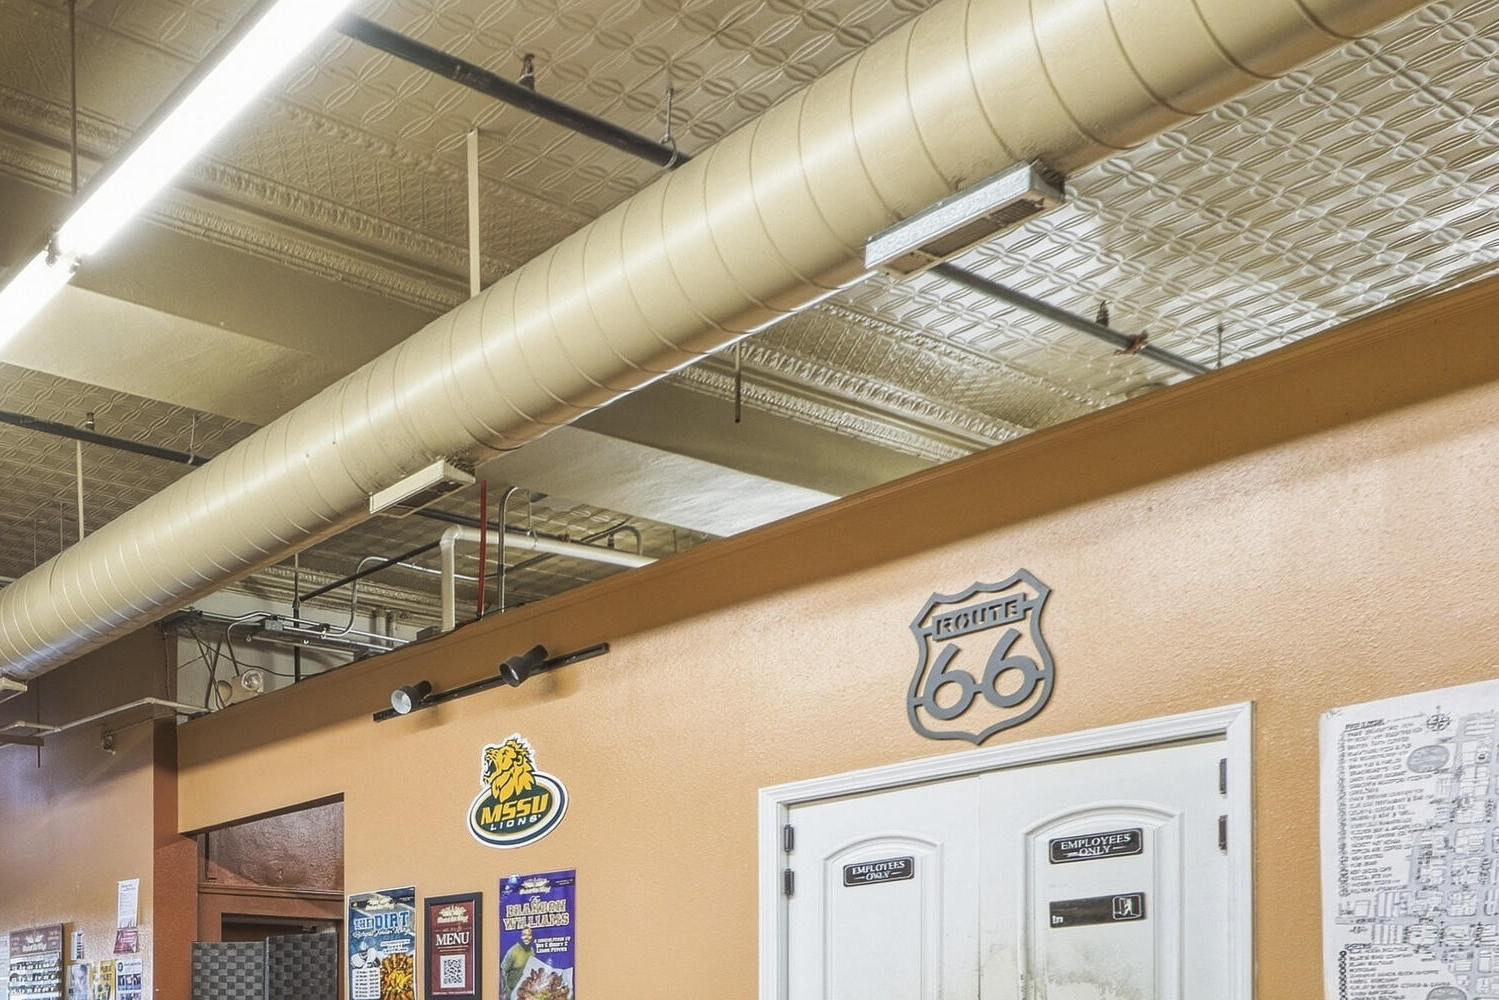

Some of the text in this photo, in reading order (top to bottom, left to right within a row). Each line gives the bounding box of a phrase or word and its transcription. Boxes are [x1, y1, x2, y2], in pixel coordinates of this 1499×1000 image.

[937, 599, 1018, 635] ROUTE
[923, 628, 1040, 721] 66
[480, 793, 549, 825] MSSU
[491, 814, 541, 831] LIONS
[1061, 833, 1132, 851] EMPLOYEES
[1078, 845, 1111, 857] ONLY
[852, 860, 905, 875] EMPLOYEES
[866, 870, 890, 880] ONLY
[374, 910, 410, 930] DIRT
[503, 912, 570, 931] WILLIAMS
[436, 932, 470, 946] MENU
